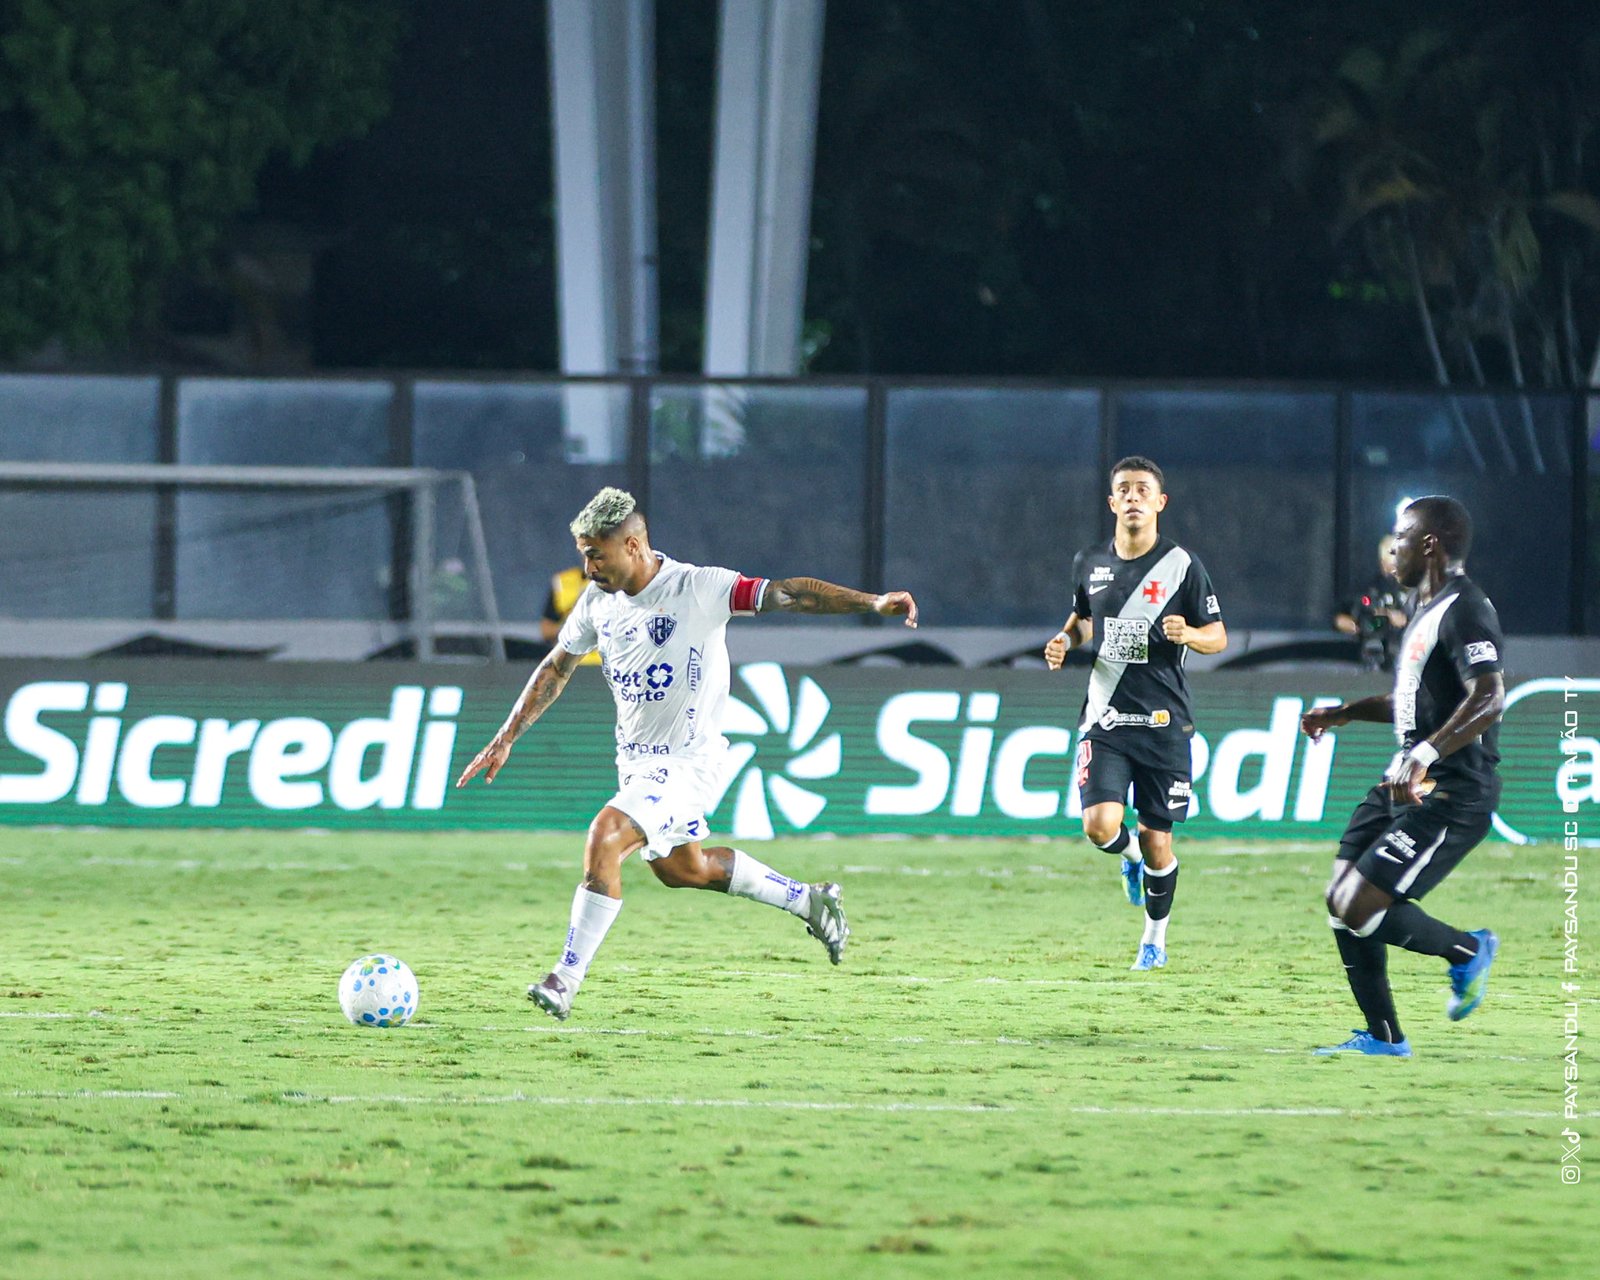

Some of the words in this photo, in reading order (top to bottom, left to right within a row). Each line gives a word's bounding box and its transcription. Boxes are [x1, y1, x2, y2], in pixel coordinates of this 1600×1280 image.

[2, 681, 464, 811] Sicredi
[620, 688, 666, 704] Sorte
[865, 691, 1342, 822] Sicdi
